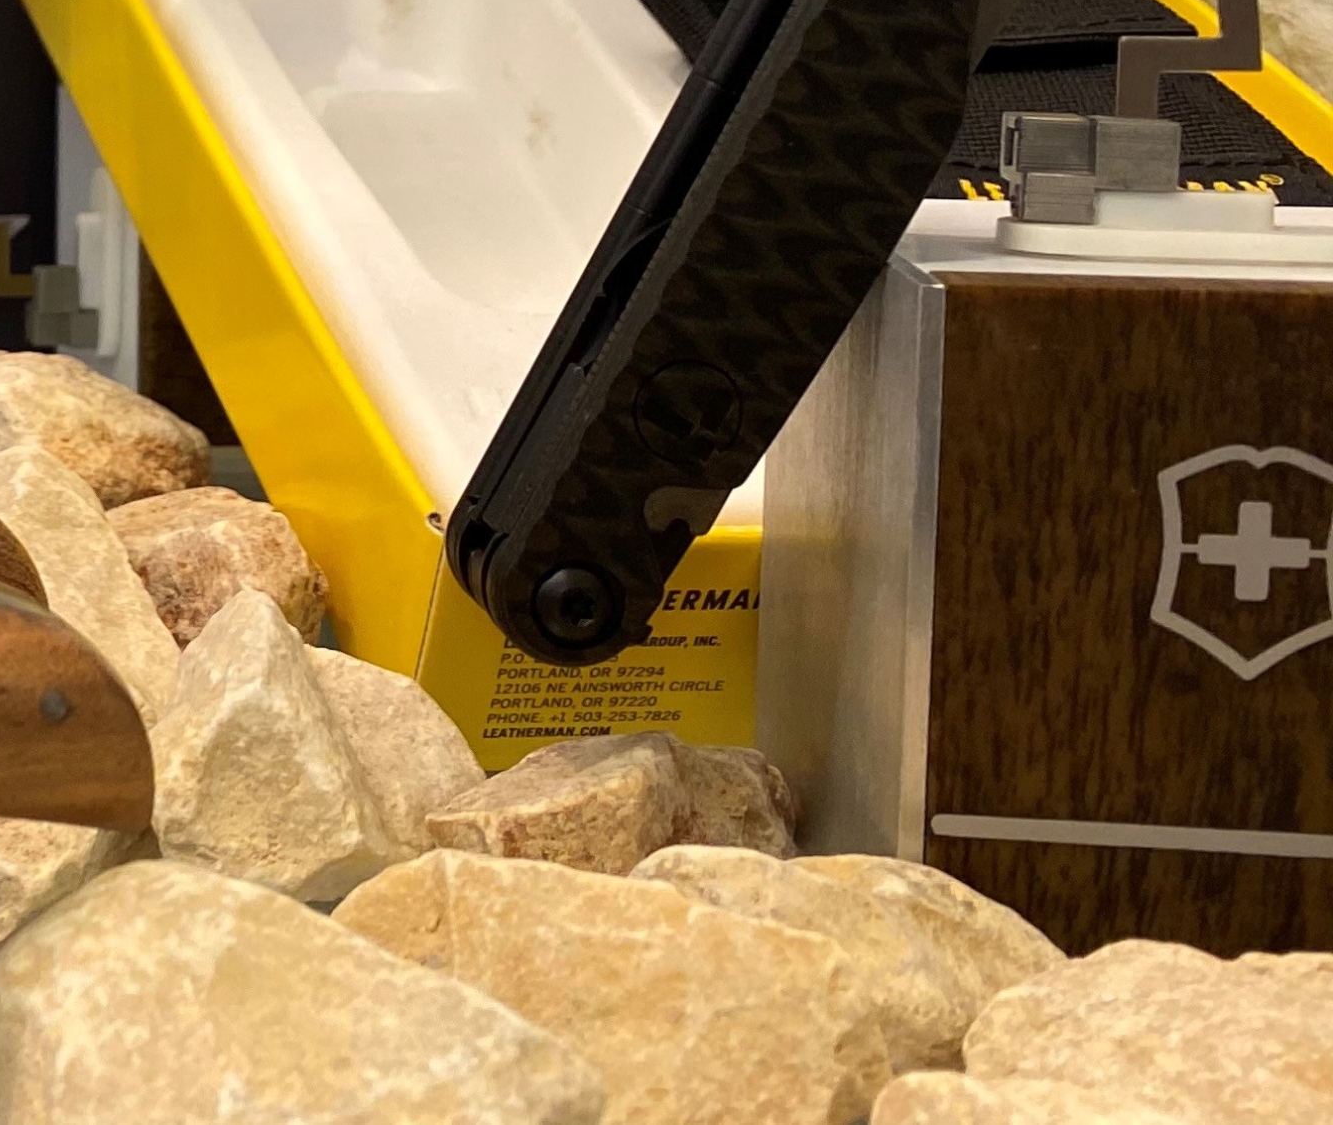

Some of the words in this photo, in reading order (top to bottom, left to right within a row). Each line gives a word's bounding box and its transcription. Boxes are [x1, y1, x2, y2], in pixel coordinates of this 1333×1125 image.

[663, 589, 760, 611] ERMA
[693, 636, 722, 648] INC.
[589, 667, 612, 678] OR
[617, 666, 665, 678] 97294
[495, 683, 541, 695] 12106
[546, 682, 568, 694] NE
[571, 680, 665, 693] AINSWORTH
[669, 680, 724, 692] CIRCLE
[581, 697, 604, 708] OR
[609, 695, 658, 708] 97220
[549, 711, 567, 723] +1
[572, 710, 681, 723] 503-253-7826
